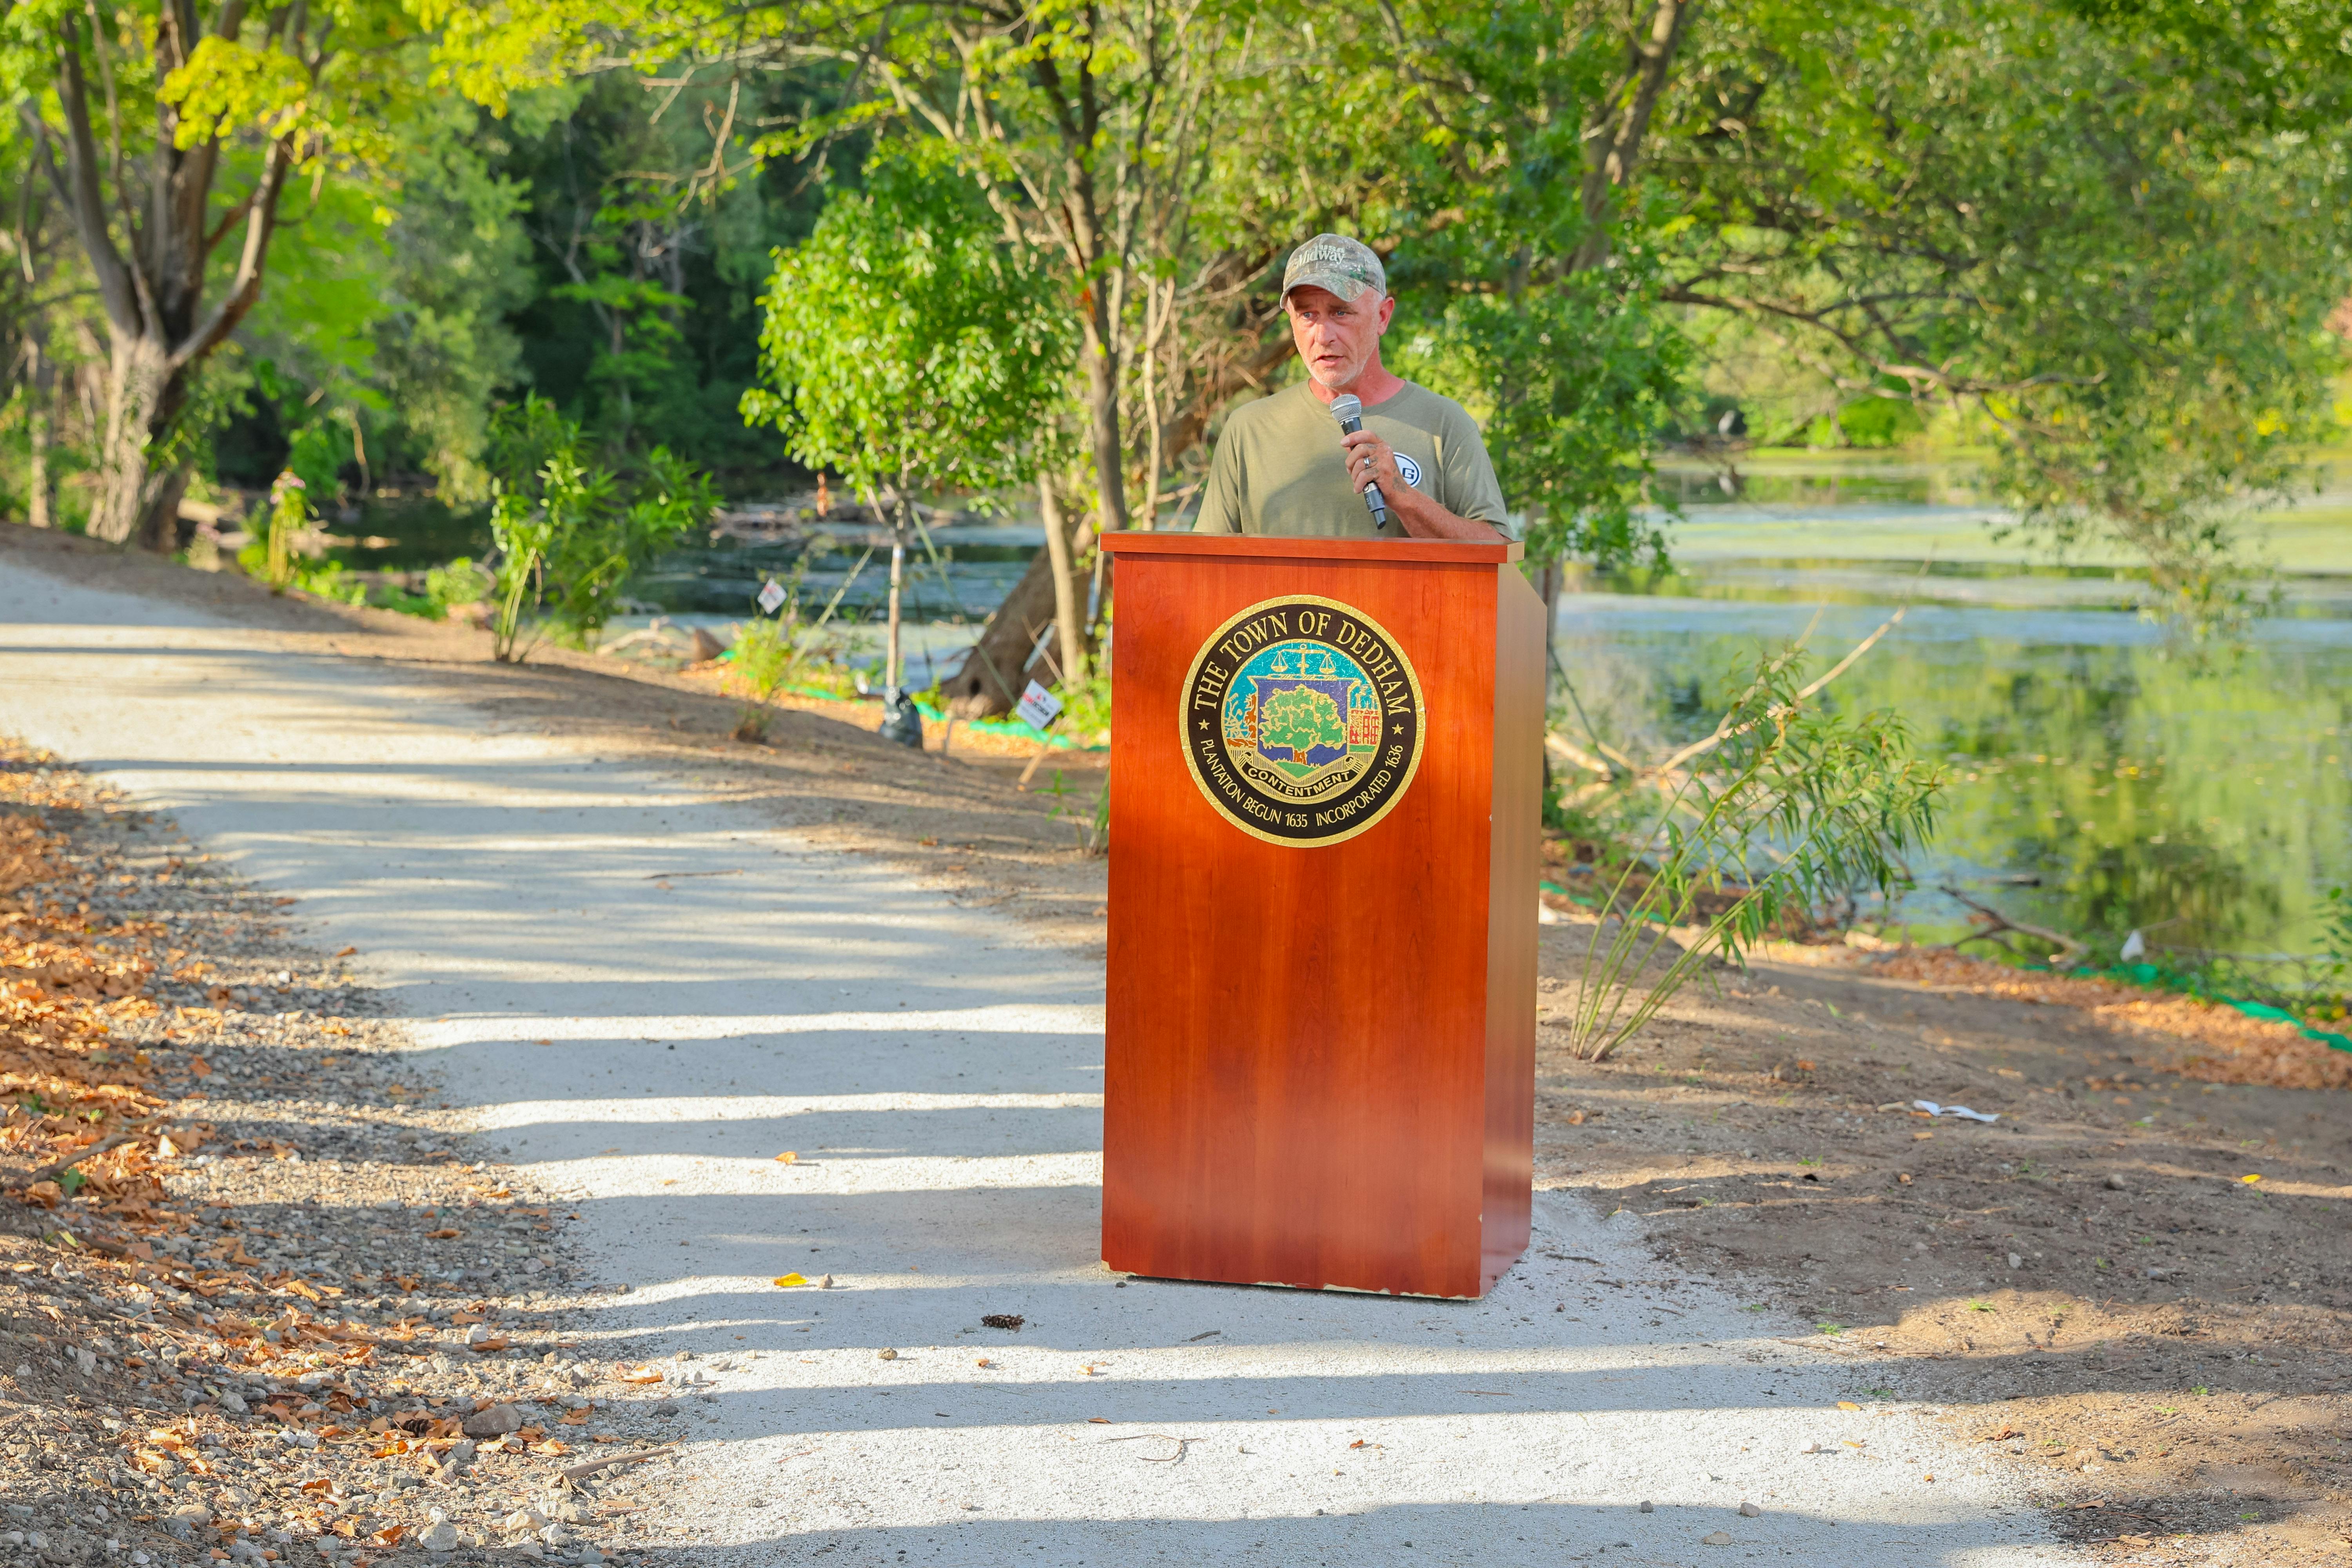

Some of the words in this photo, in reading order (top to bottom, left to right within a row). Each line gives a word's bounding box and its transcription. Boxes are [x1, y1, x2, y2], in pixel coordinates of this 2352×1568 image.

[1297, 245, 1345, 268] Midway
[1403, 468, 1414, 479] G
[1194, 661, 1229, 710] THE
[1219, 612, 1288, 662] TOWN
[1298, 611, 1331, 636] OF
[1336, 620, 1411, 716] DEDHAM
[1200, 739, 1246, 803] PLANTATION
[1242, 796, 1282, 824] BEGUN
[1285, 813, 1308, 828] 1635
[1316, 769, 1392, 827] INCORPORATED
[1385, 744, 1403, 768] 1636
[1248, 767, 1350, 796] CONTENTMENT
